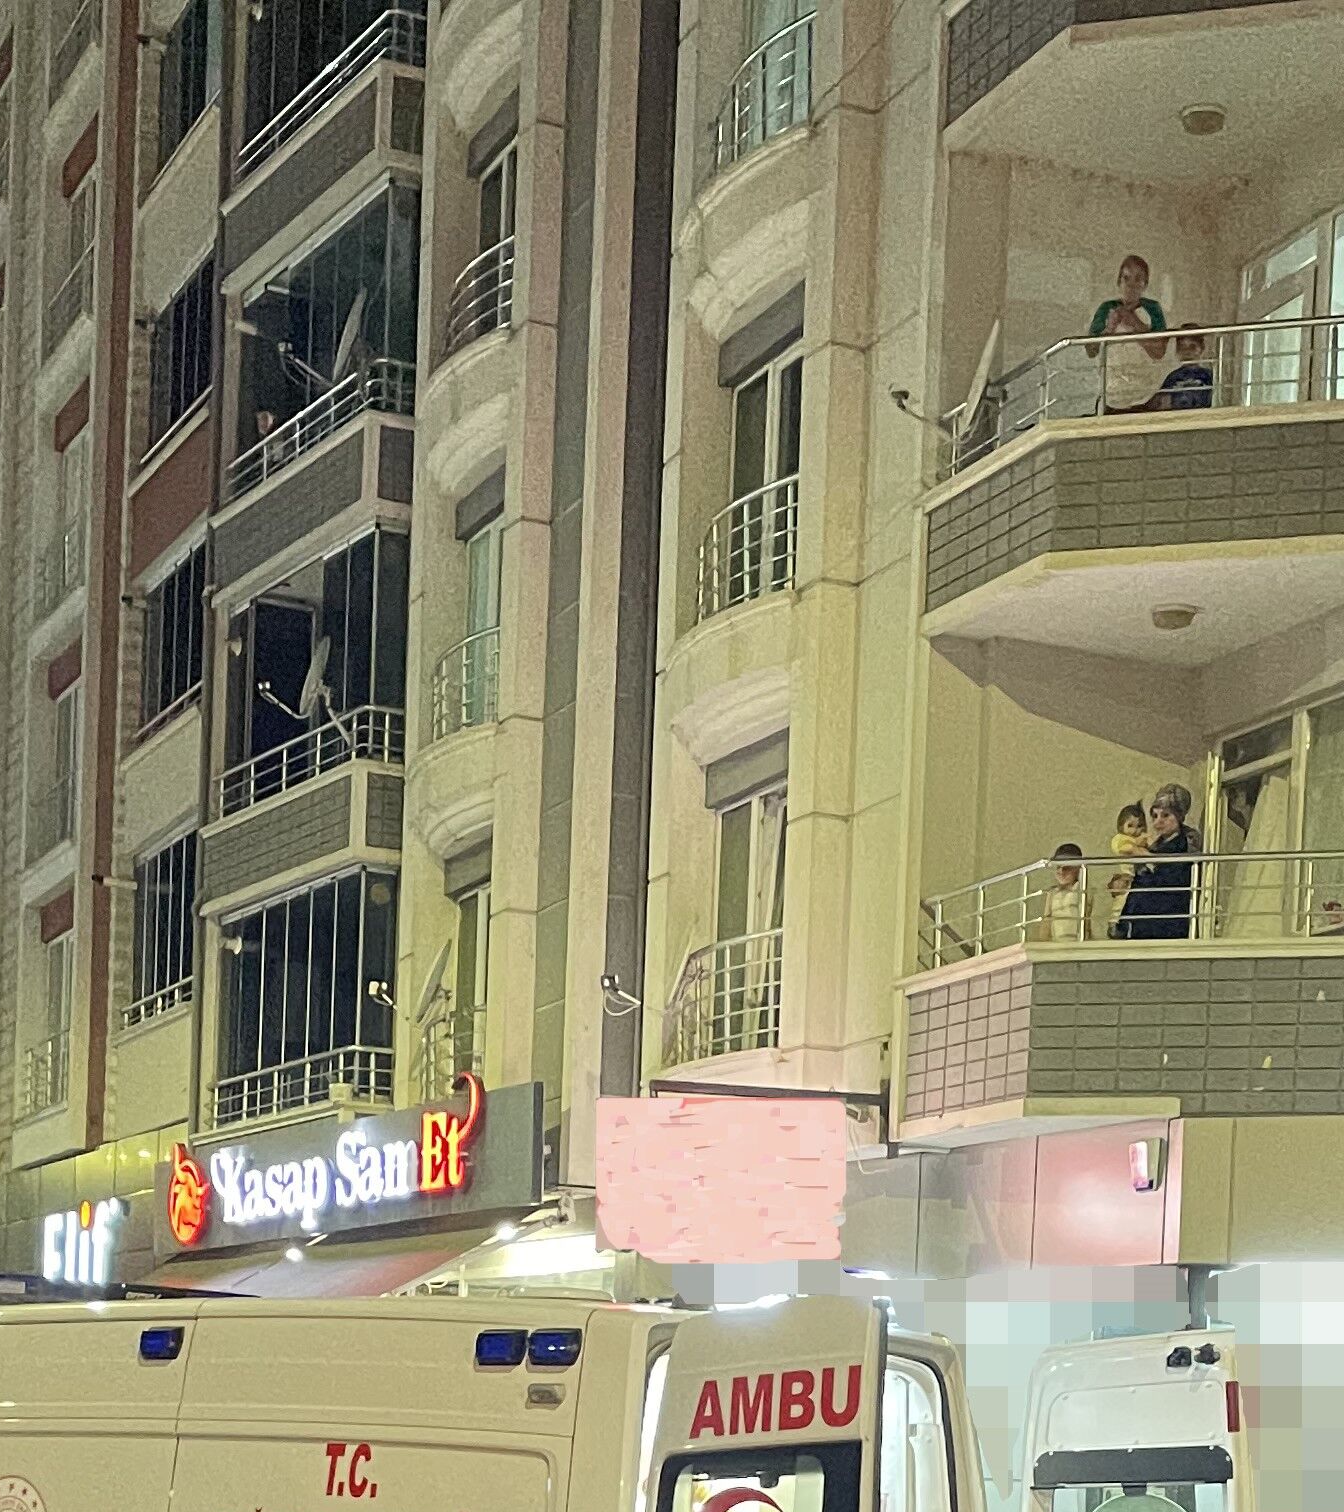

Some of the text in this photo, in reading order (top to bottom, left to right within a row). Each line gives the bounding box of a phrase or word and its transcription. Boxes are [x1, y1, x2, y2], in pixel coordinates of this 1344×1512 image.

[210, 1146, 328, 1230] Kasap
[689, 1365, 862, 1439] AMBU
[326, 1443, 378, 1498] T.C.
